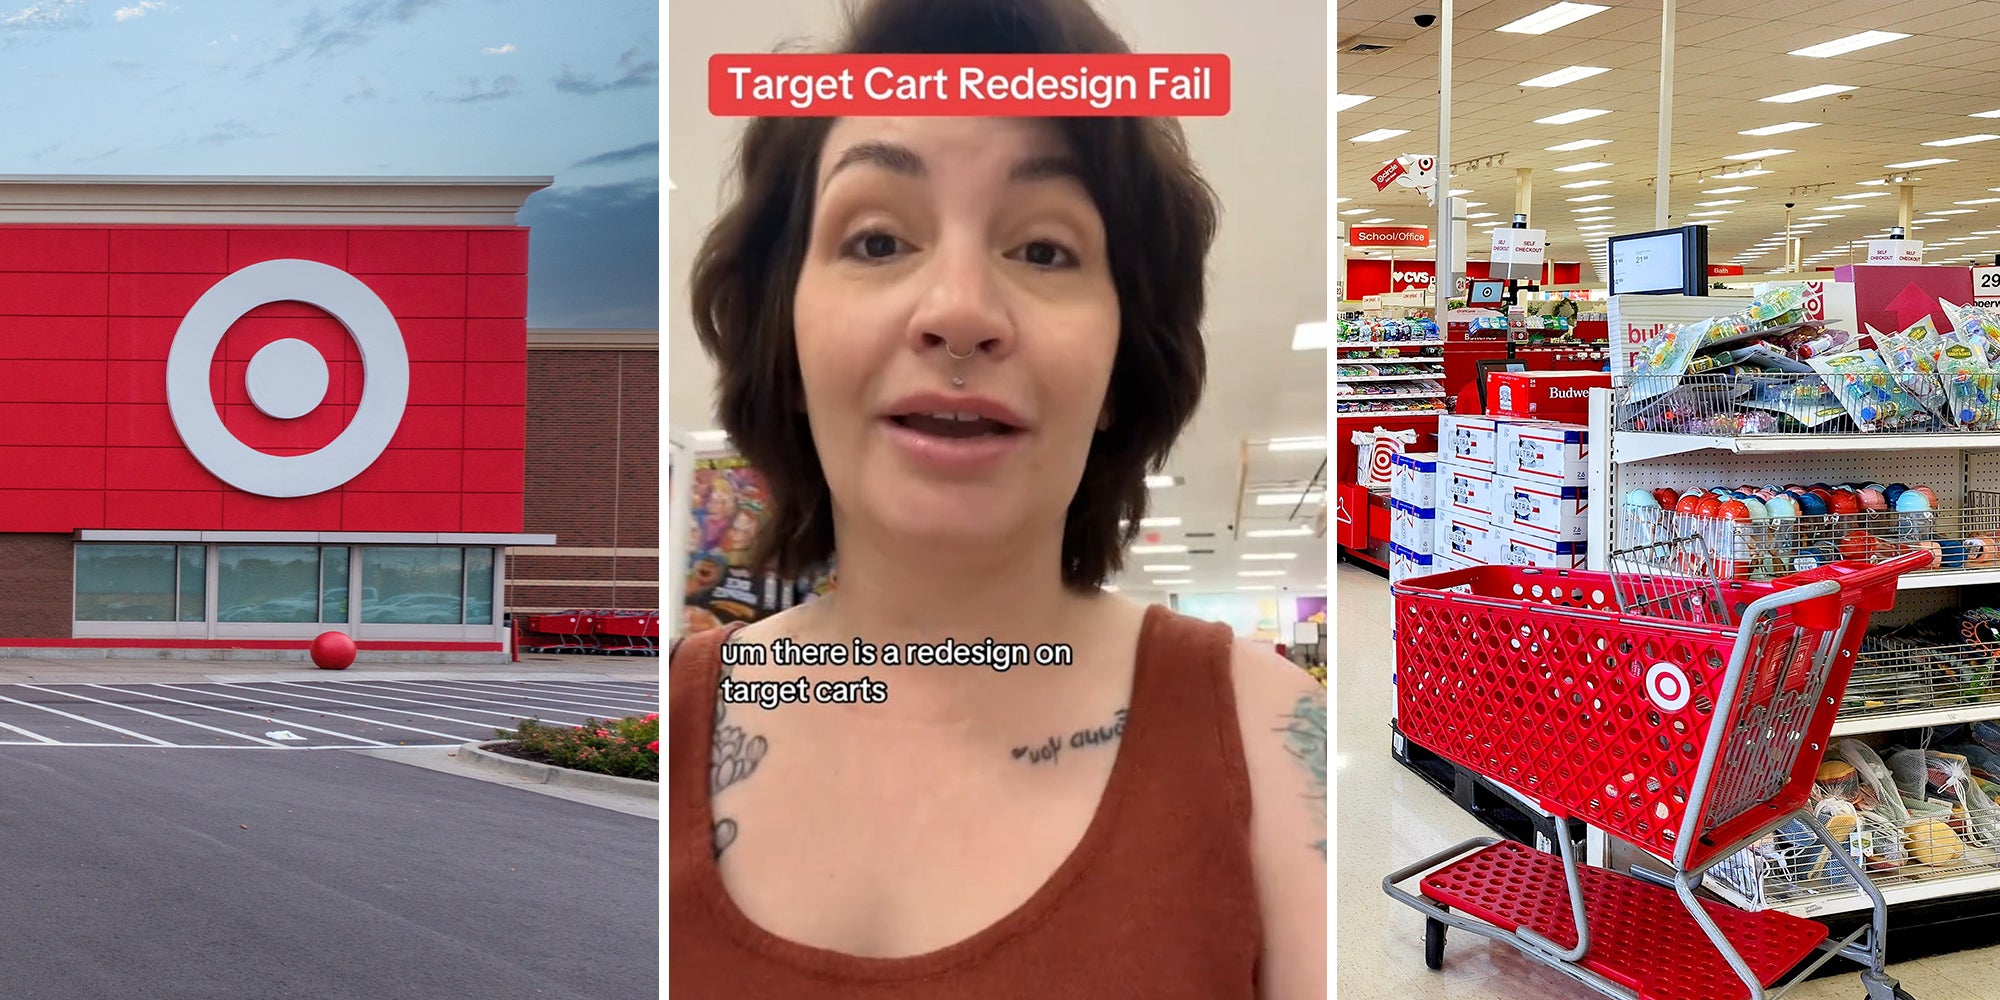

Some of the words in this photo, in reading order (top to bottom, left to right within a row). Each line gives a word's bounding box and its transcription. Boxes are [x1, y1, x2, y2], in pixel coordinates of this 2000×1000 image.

[1358, 232, 1425, 242] School/Office
[1403, 271, 1429, 283] CVS
[1981, 273, 2000, 288] 29
[1549, 387, 1589, 399] Budwe
[1514, 449, 1535, 459] ULTRA
[1510, 501, 1531, 511] ULTRA
[1506, 553, 1526, 564] ULTRA
